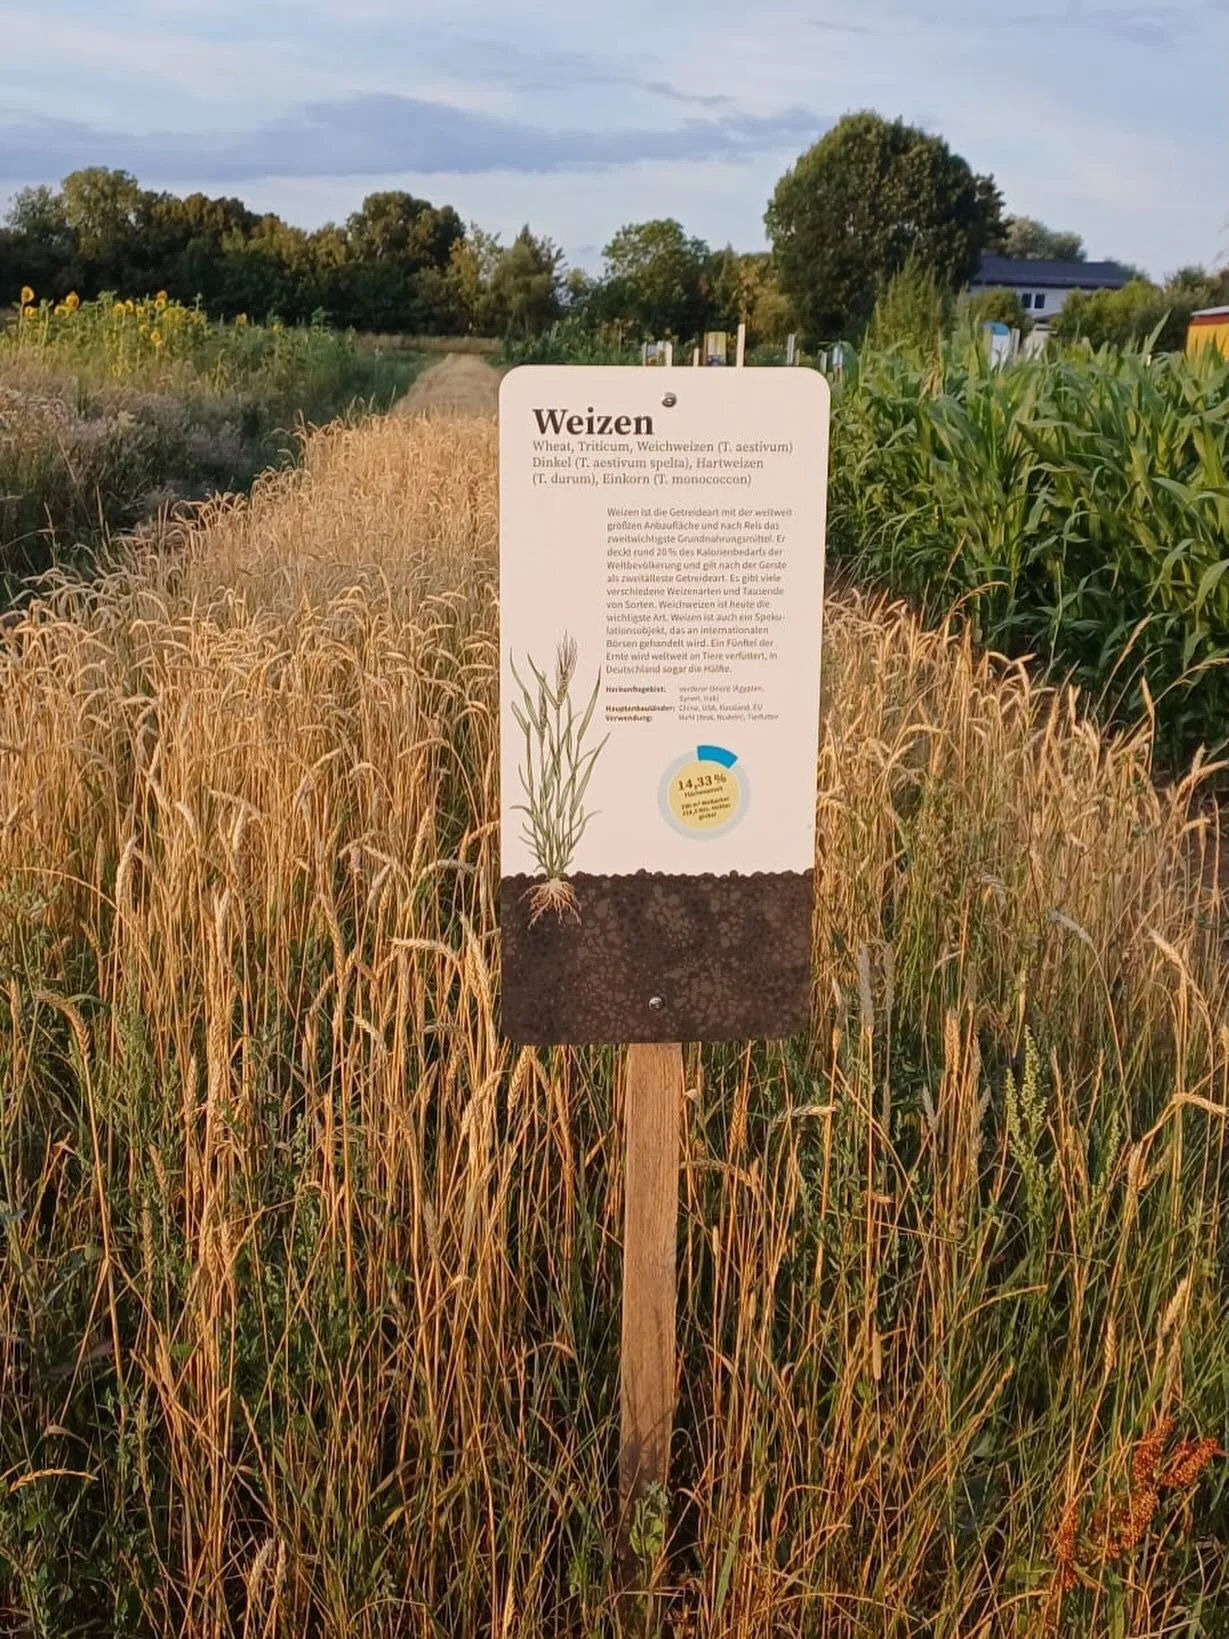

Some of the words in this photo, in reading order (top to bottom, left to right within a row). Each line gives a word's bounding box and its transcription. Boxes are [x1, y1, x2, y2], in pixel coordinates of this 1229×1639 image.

[532, 406, 654, 435] Weizen
[532, 440, 574, 453] Wheat,
[578, 440, 633, 454] Triticum,
[637, 441, 714, 452] Weichweizen
[718, 441, 732, 454] (T.
[736, 441, 794, 454] aestivum)
[532, 457, 571, 469] Dinkel
[575, 457, 590, 470] (T.
[593, 458, 646, 469] aestivum
[650, 457, 693, 470] spelta),
[696, 457, 764, 468] Hartweizen
[532, 474, 547, 486] (T.
[551, 474, 599, 486] durum),
[603, 474, 650, 485] Einkorn
[654, 474, 669, 486] (T.
[608, 508, 639, 517] Weizen
[641, 508, 651, 517] ist
[654, 508, 667, 517] die
[669, 508, 719, 517] Getreideart
[721, 508, 736, 517] mit
[738, 508, 752, 517] der
[755, 508, 792, 517] weltweit
[608, 521, 642, 531] größten
[644, 521, 699, 530] Anbaufläche
[701, 521, 718, 530] und
[721, 521, 742, 530] nach
[745, 521, 762, 530] Reis
[764, 521, 779, 530] das
[608, 535, 676, 545] zweitwichtigste
[777, 535, 785, 543] Er
[607, 548, 631, 557] deckt
[633, 548, 654, 557] rund
[679, 548, 694, 557] des
[697, 548, 766, 557] Kalorienbedarfs
[768, 548, 782, 557] der
[607, 561, 681, 571] Weltbevölkerung
[684, 561, 700, 570] und
[703, 561, 717, 571] gilt
[719, 561, 740, 570] nach
[742, 561, 757, 570] der
[759, 561, 786, 570] Gerste
[607, 574, 619, 583] als
[730, 574, 740, 583] Es
[743, 574, 758, 584] gibt
[761, 574, 780, 583] viele
[607, 587, 665, 596] verschiedene
[667, 587, 721, 596] Weizenarten
[724, 587, 740, 596] und
[743, 587, 784, 596] Tausende
[607, 600, 623, 609] von
[625, 600, 656, 609] Sorten.
[659, 600, 715, 609] Weichweizen
[718, 600, 728, 609] ist
[730, 600, 754, 609] heute
[757, 600, 770, 609] die
[607, 613, 651, 623] wichtigste
[654, 613, 666, 622] Art.
[671, 613, 702, 622] Weizen
[704, 613, 714, 622] ist
[717, 613, 737, 622] auch
[739, 613, 752, 622] ein
[670, 626, 685, 634] das
[687, 626, 698, 634] an
[701, 626, 768, 634] internationalen
[607, 639, 637, 647] Börsen
[640, 639, 684, 649] gehandelt
[686, 639, 708, 647] wird.
[712, 639, 724, 647] Ein
[727, 639, 757, 647] Fünftel
[759, 639, 773, 647] der
[607, 652, 629, 660] Ernte
[632, 652, 649, 660] wird
[652, 652, 687, 660] weltweit
[690, 652, 700, 660] an
[703, 652, 723, 660] Tiere
[770, 652, 777, 660] in
[607, 665, 660, 673] Deutschland
[663, 665, 686, 675] sogar
[688, 665, 702, 673] die
